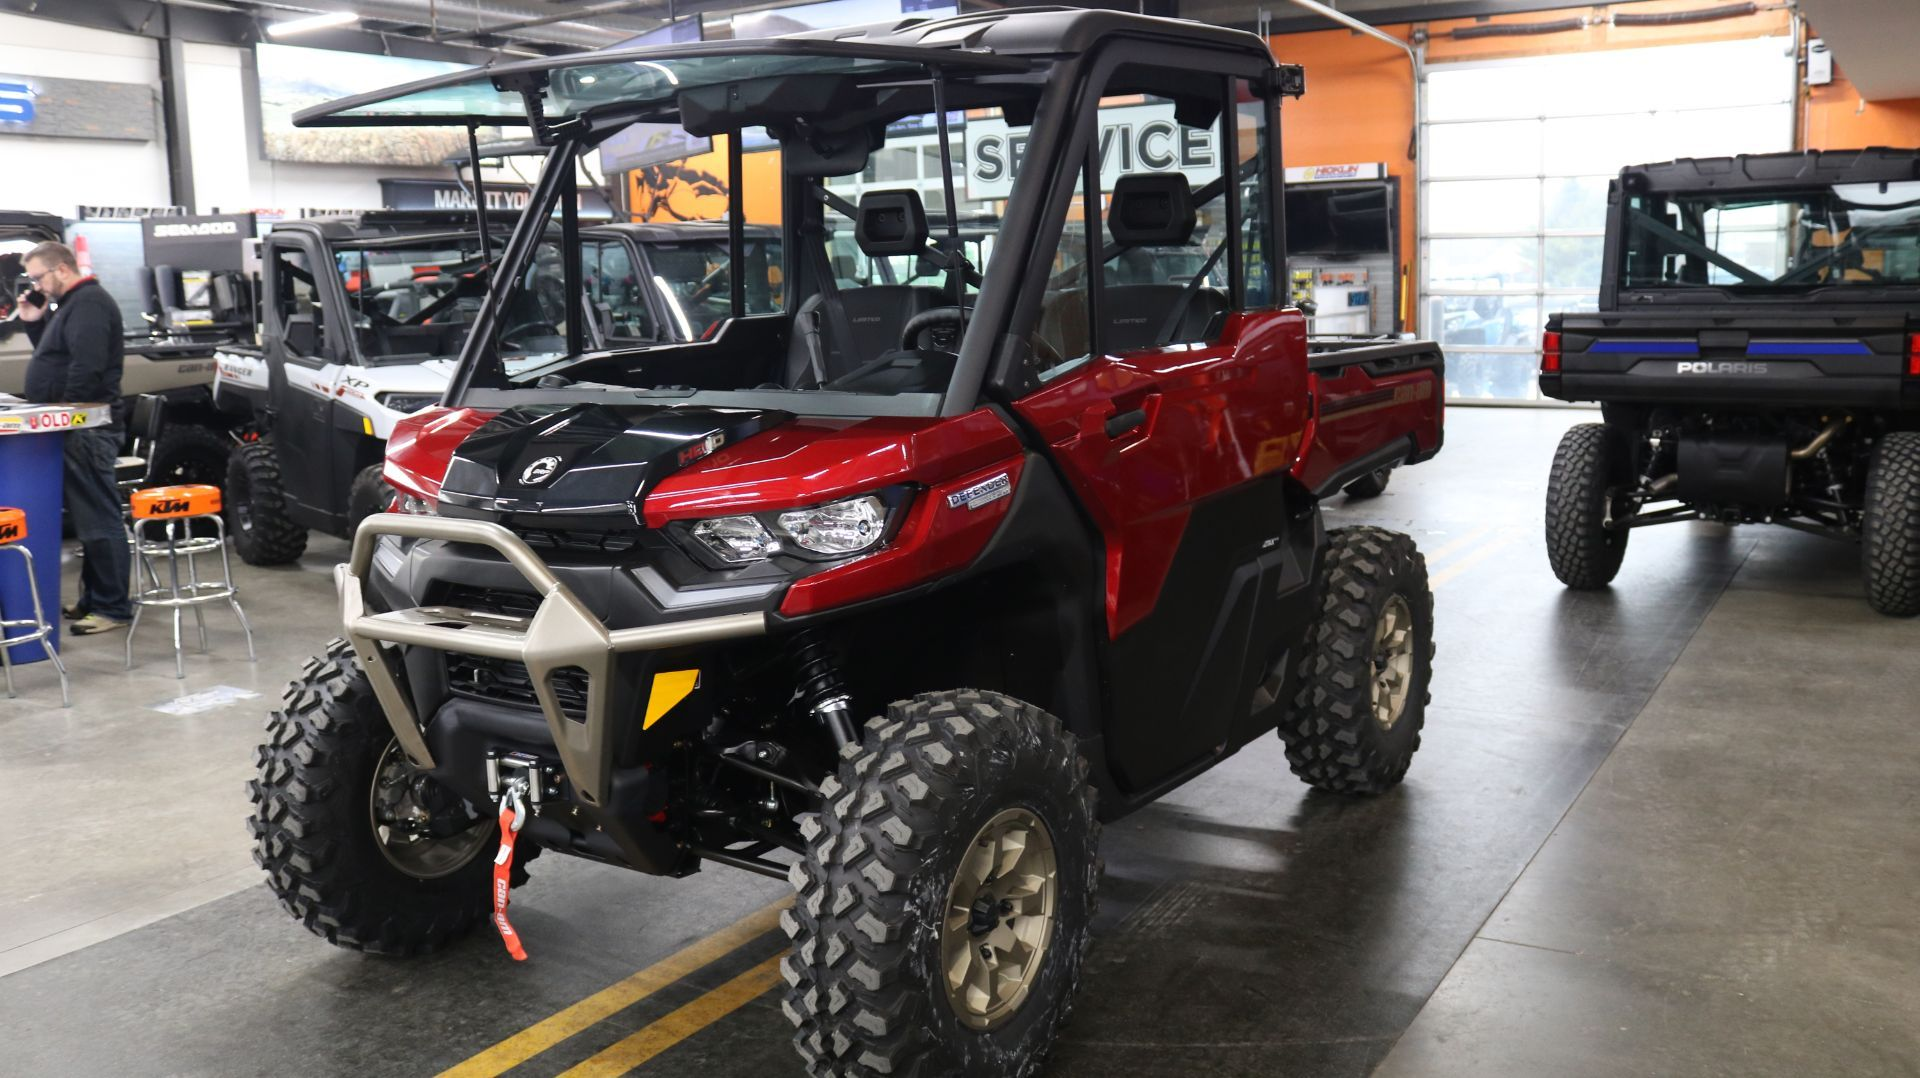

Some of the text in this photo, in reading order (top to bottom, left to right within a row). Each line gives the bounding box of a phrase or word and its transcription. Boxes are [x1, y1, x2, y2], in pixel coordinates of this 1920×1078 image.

[973, 119, 1216, 183] SEVICE
[224, 363, 253, 377] RANGER
[1677, 361, 1768, 374] POLARIS
[341, 375, 370, 388] XP
[951, 474, 1009, 505] DEFENDER
[150, 500, 190, 515] KTM
